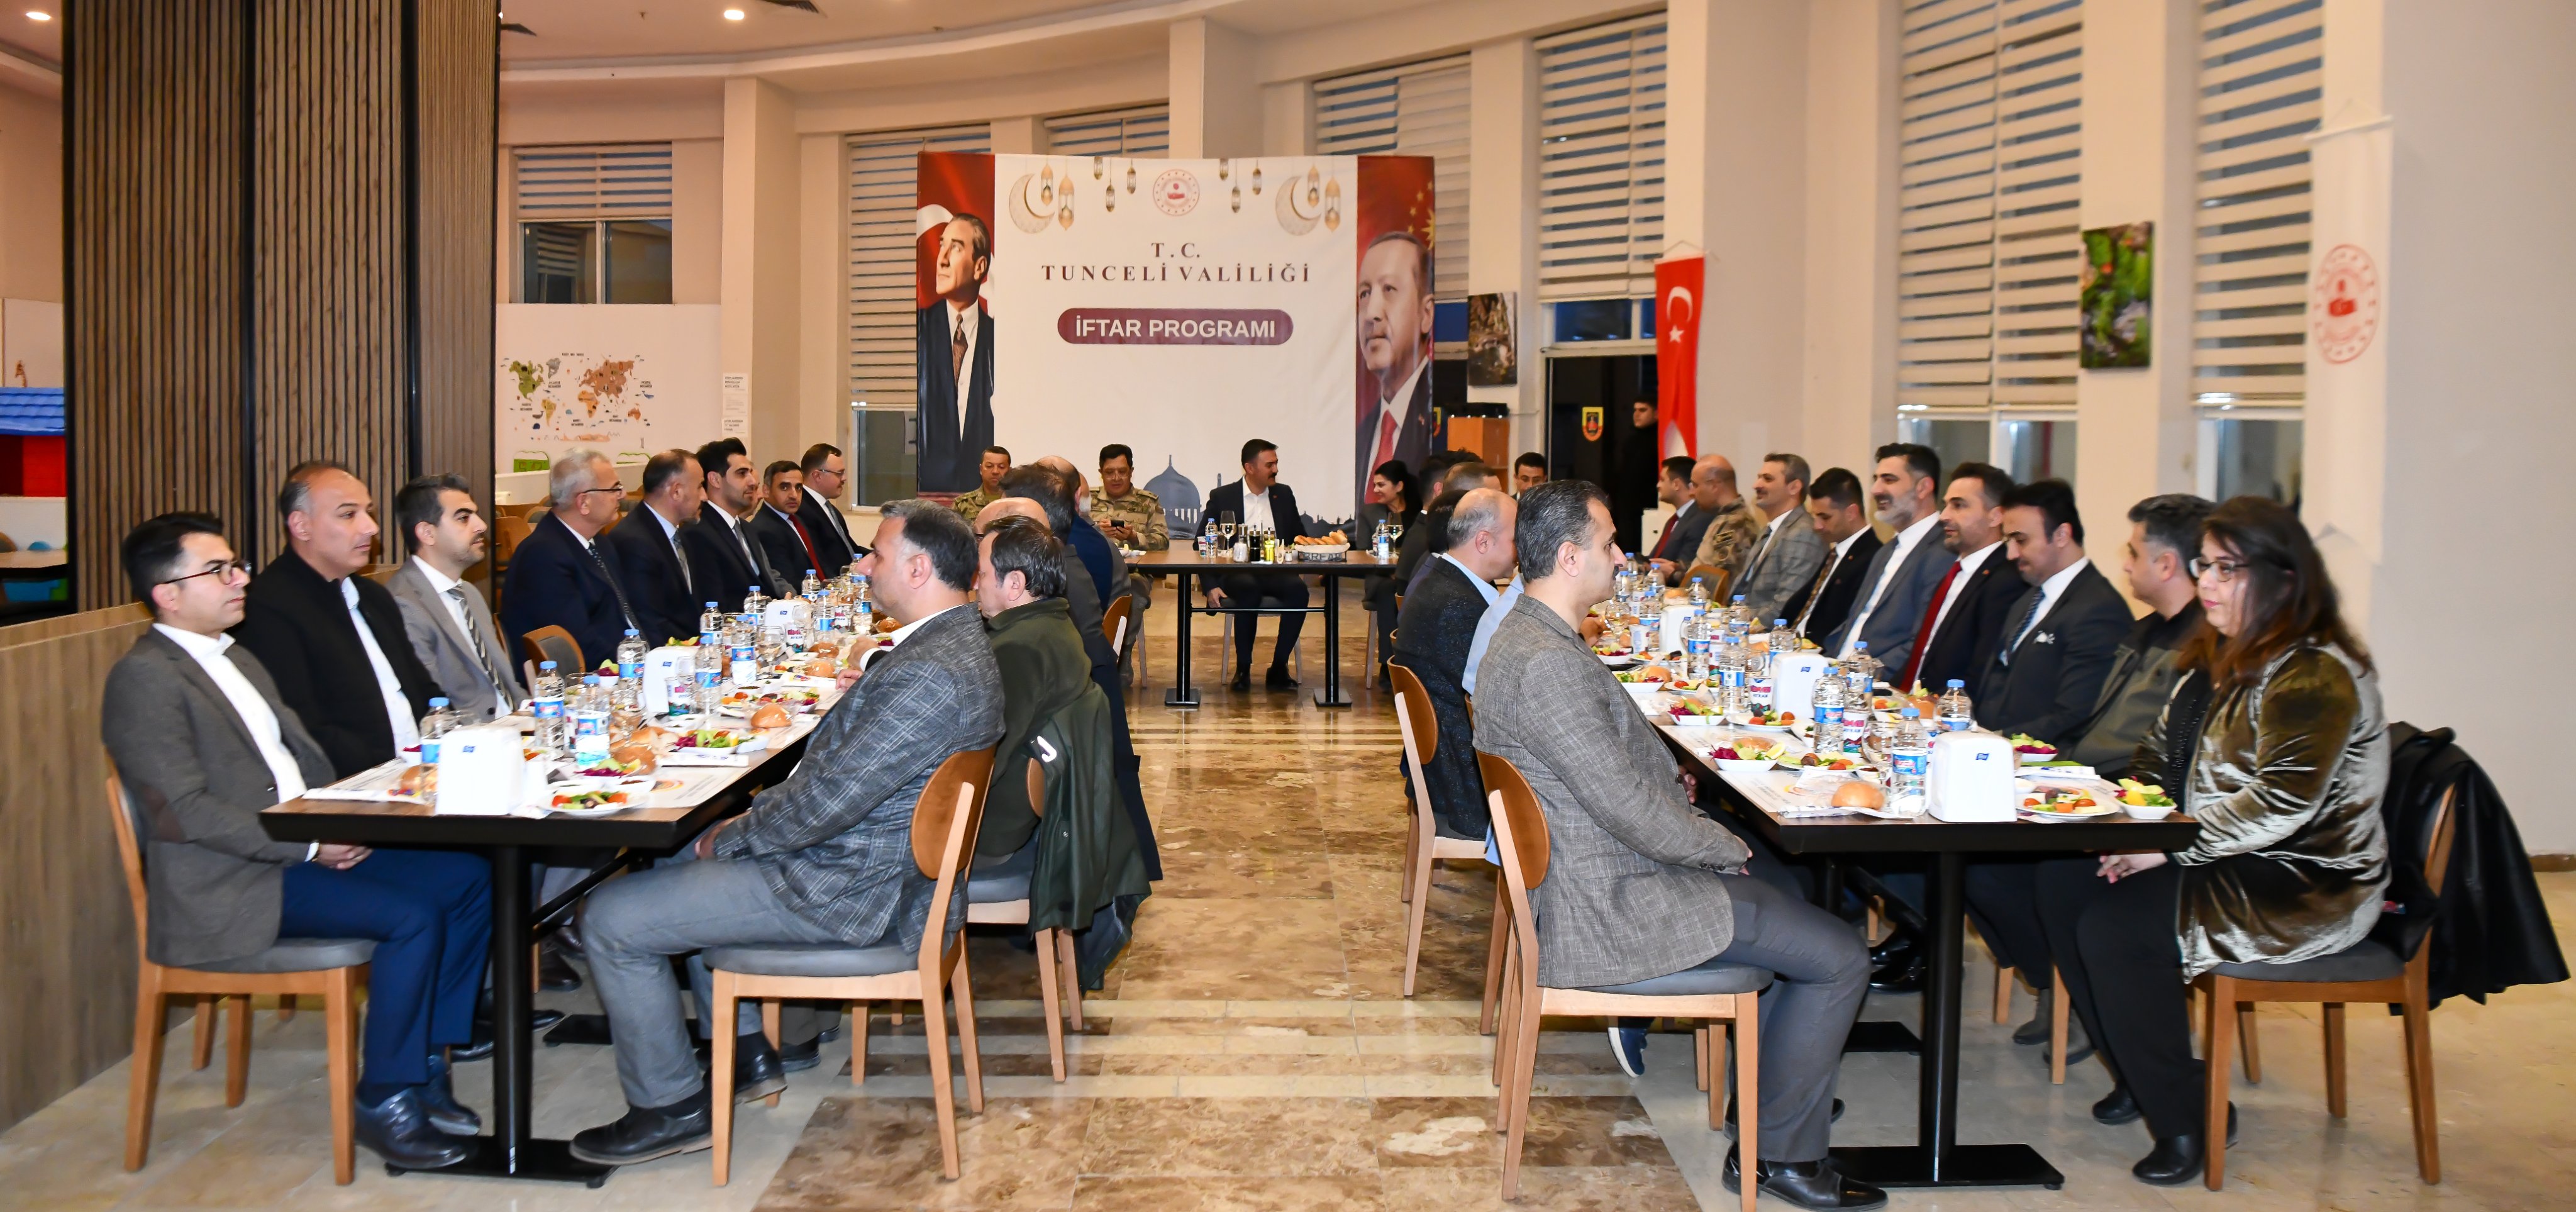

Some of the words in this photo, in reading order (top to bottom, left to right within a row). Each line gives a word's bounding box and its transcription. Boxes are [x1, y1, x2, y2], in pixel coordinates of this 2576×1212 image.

[1041, 263, 1167, 282] TUNCELİ
[1179, 263, 1309, 282] VALİLİĞİ
[1076, 315, 1141, 337] İFTAR
[1149, 320, 1275, 338] PROGRAMI
[1304, 552, 1343, 562] BREAD
